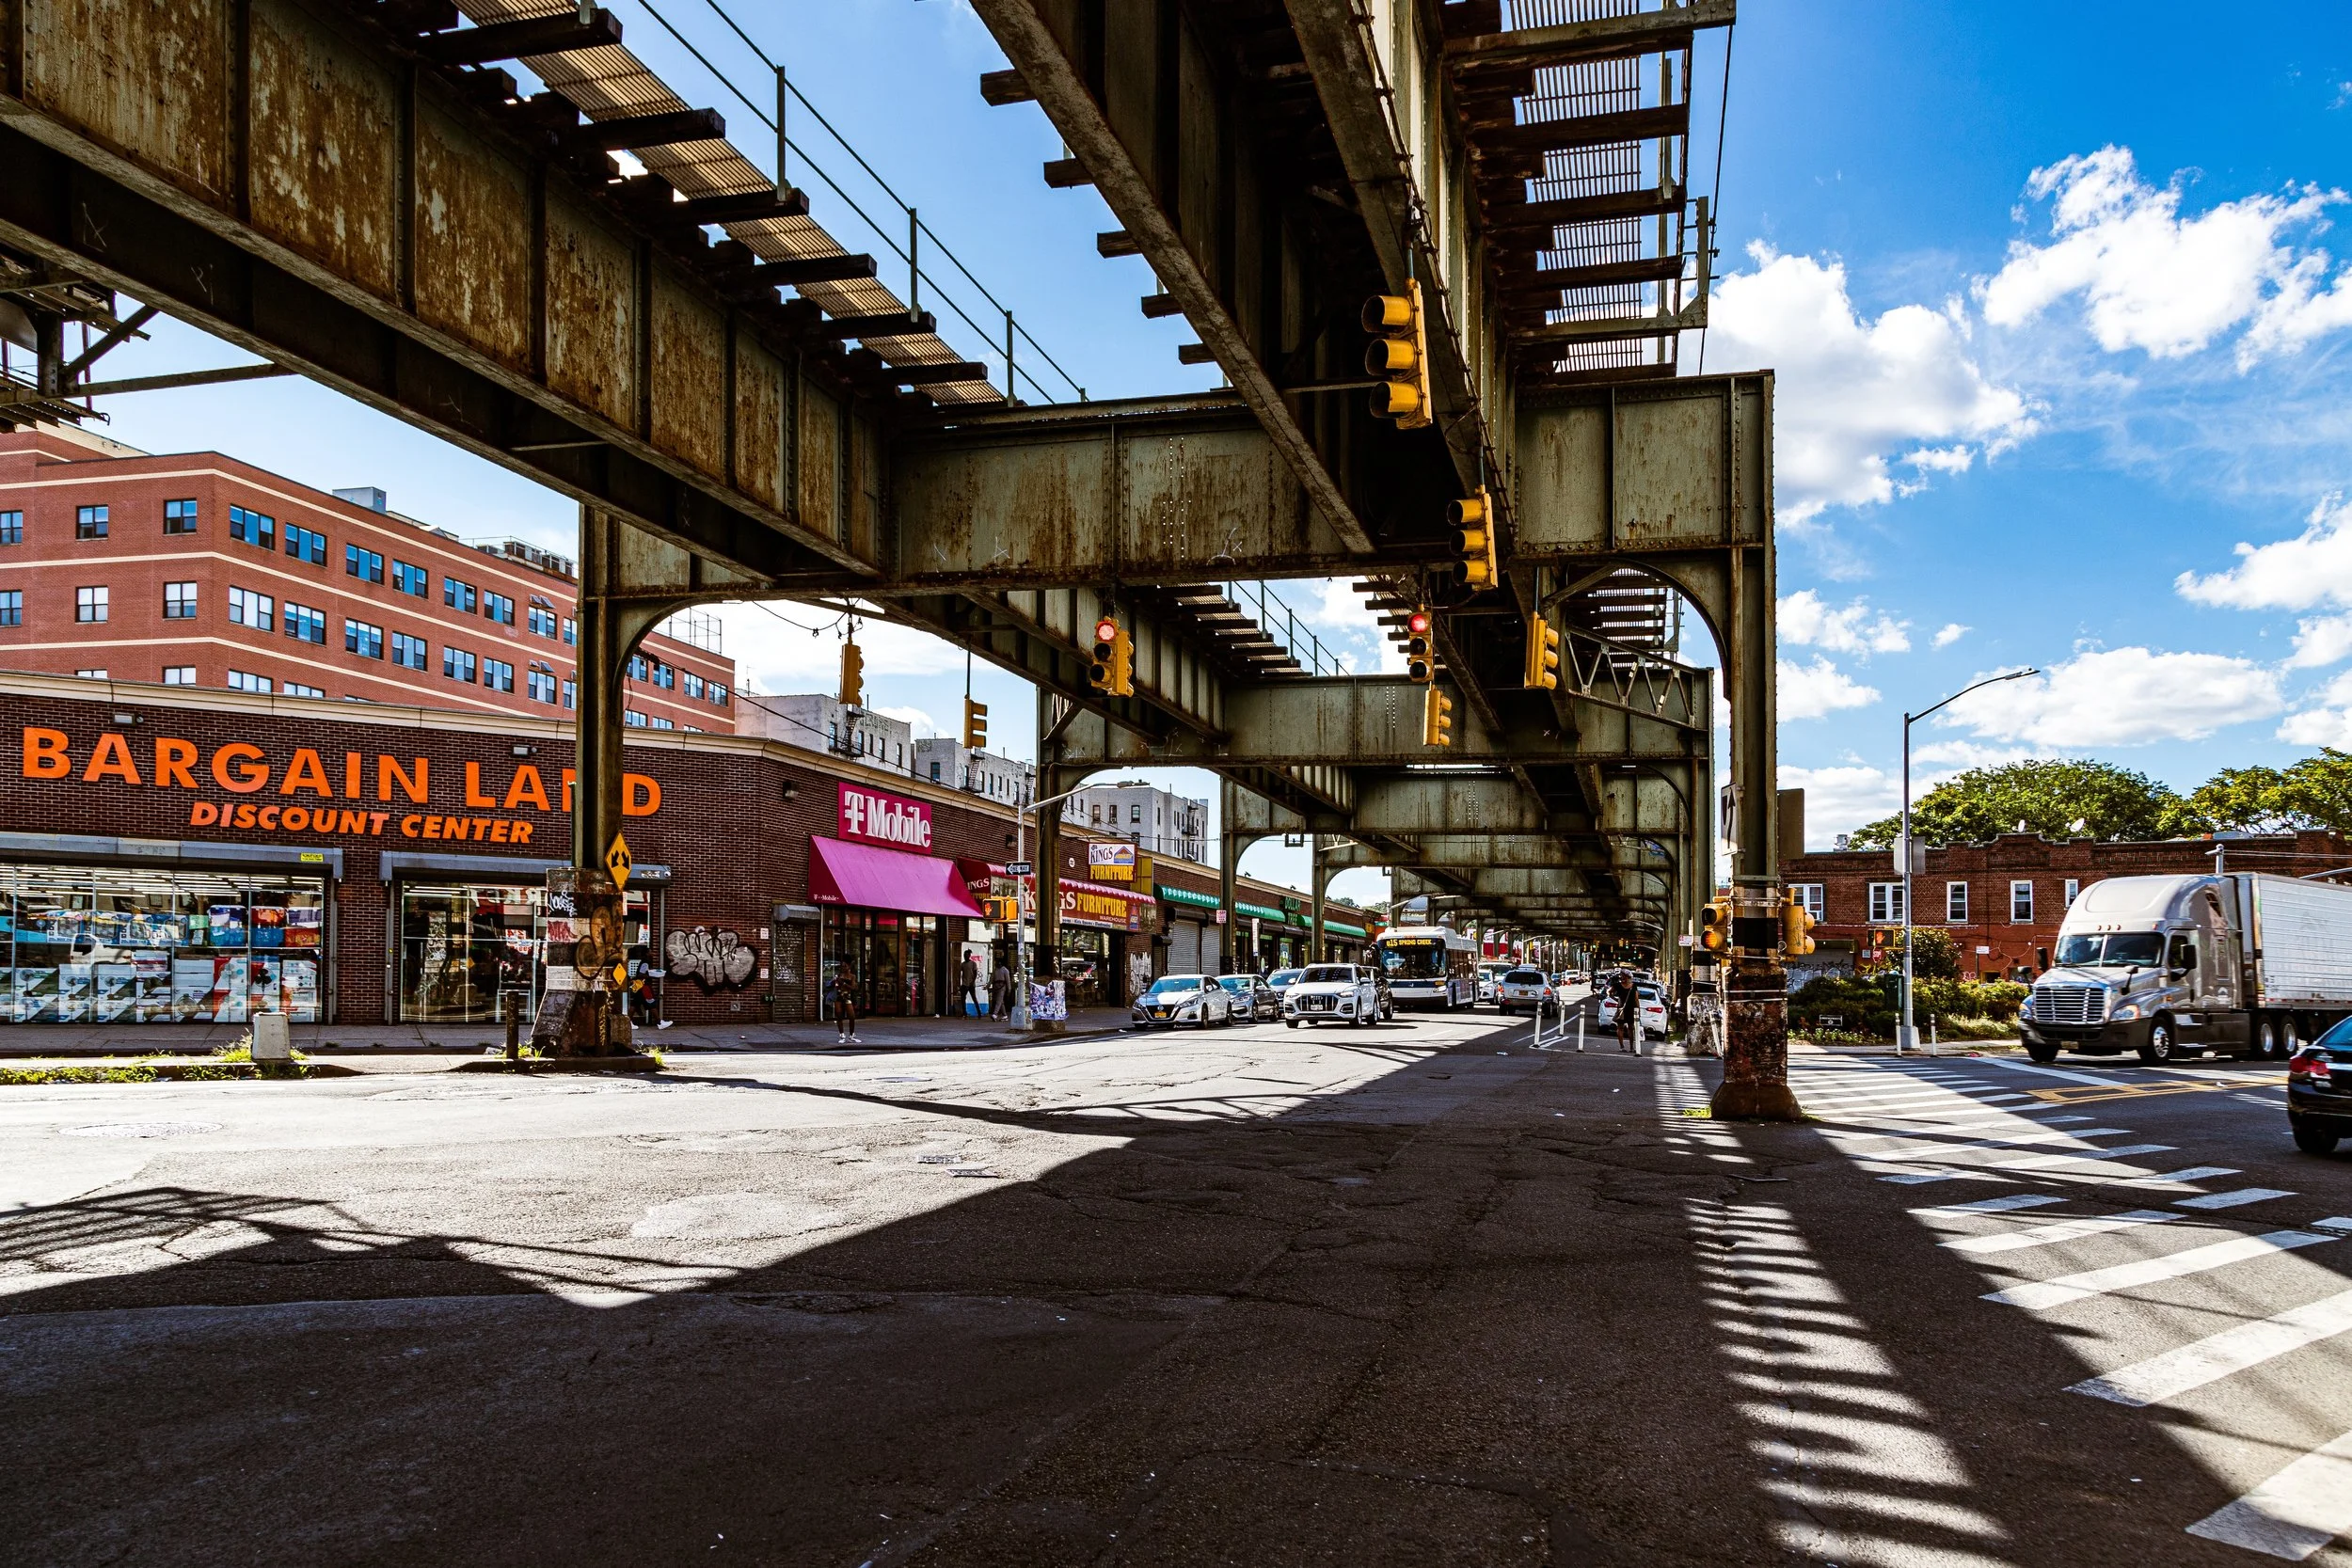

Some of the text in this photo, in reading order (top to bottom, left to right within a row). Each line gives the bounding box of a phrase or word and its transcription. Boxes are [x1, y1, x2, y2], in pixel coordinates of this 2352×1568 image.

[23, 726, 661, 816] BARGAIN LAD
[190, 801, 533, 843] DISCOUNT CENTER
[1090, 847, 1113, 863] KINGS
[1090, 864, 1134, 880] FURNITURE
[967, 879, 990, 890] INGS
[1024, 891, 1127, 918] KGS FURNITURE
[1284, 896, 1301, 911] DOLLAR
[1099, 915, 1127, 924] WAREHOUSE
[1287, 911, 1298, 927] TREE
